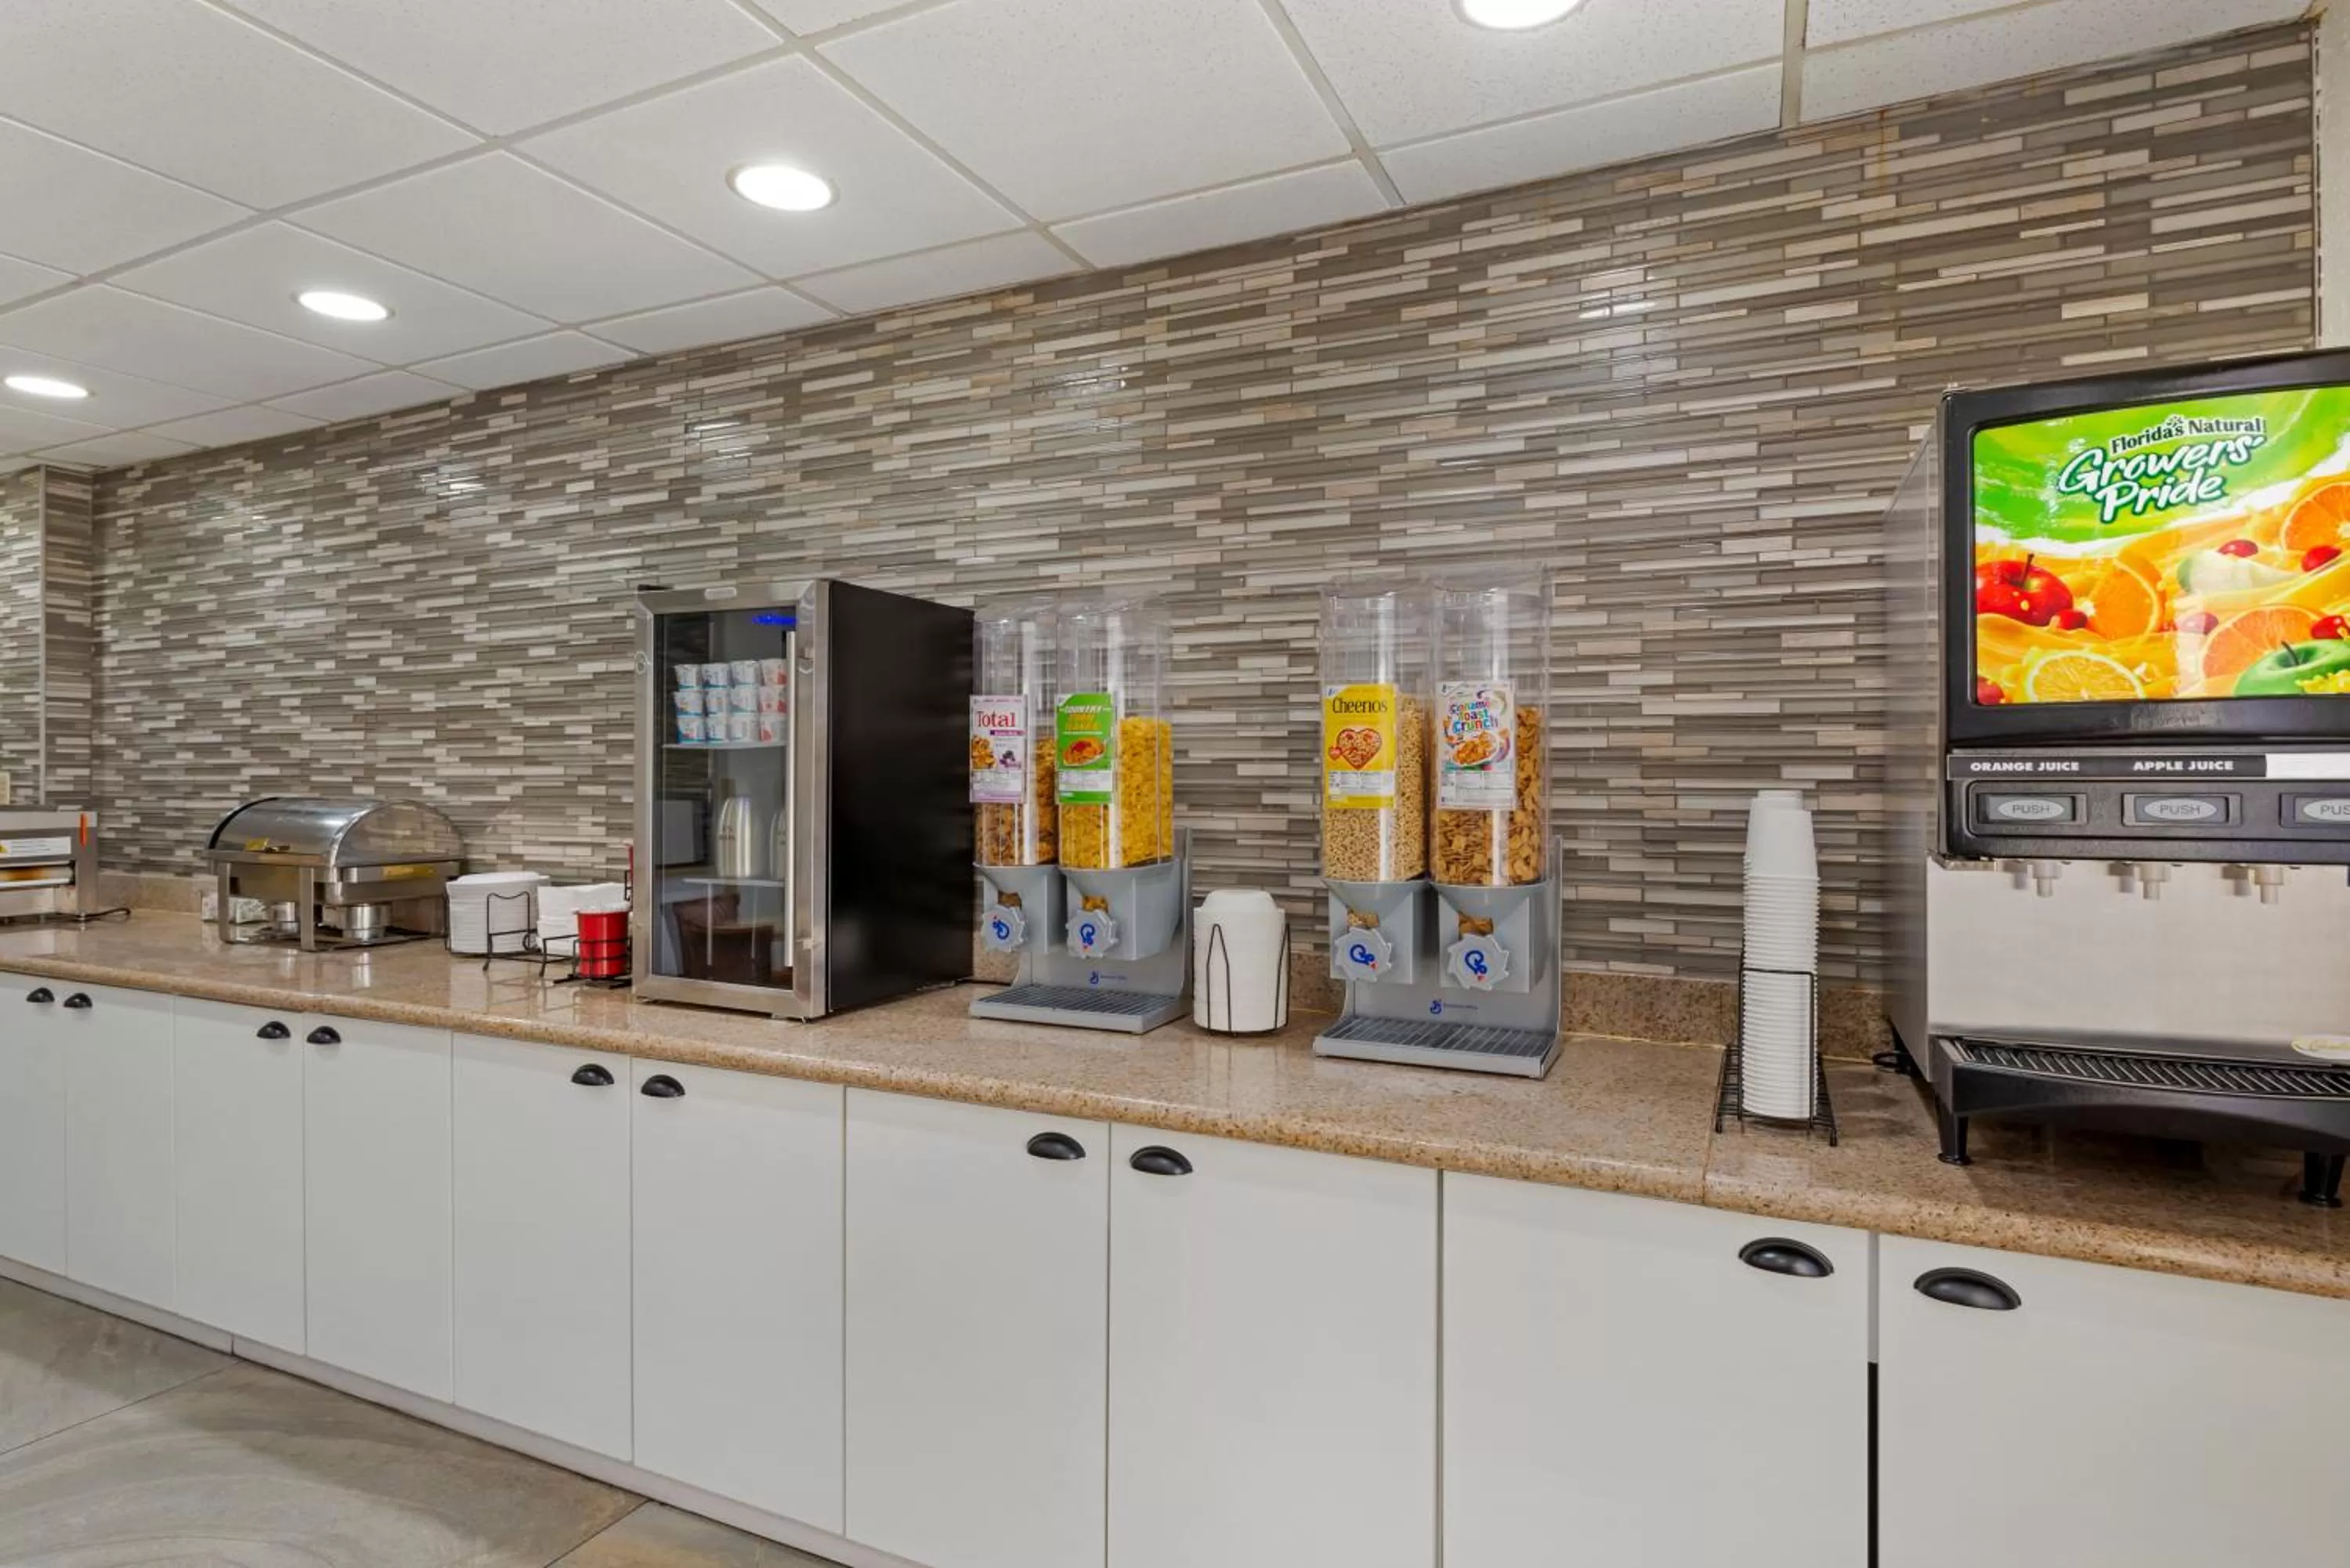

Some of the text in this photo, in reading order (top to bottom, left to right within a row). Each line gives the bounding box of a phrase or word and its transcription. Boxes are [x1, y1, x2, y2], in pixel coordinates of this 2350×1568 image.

[2189, 417, 2261, 434] Natural
[2095, 468, 2223, 522] Pride
[977, 710, 1016, 728] Total
[1970, 761, 2080, 771] ORANGE JUICE
[2133, 761, 2234, 771] APPLE JUICE
[2012, 804, 2050, 815] PUSH
[2159, 804, 2200, 815] PUSH
[2319, 804, 2350, 816] PUS
